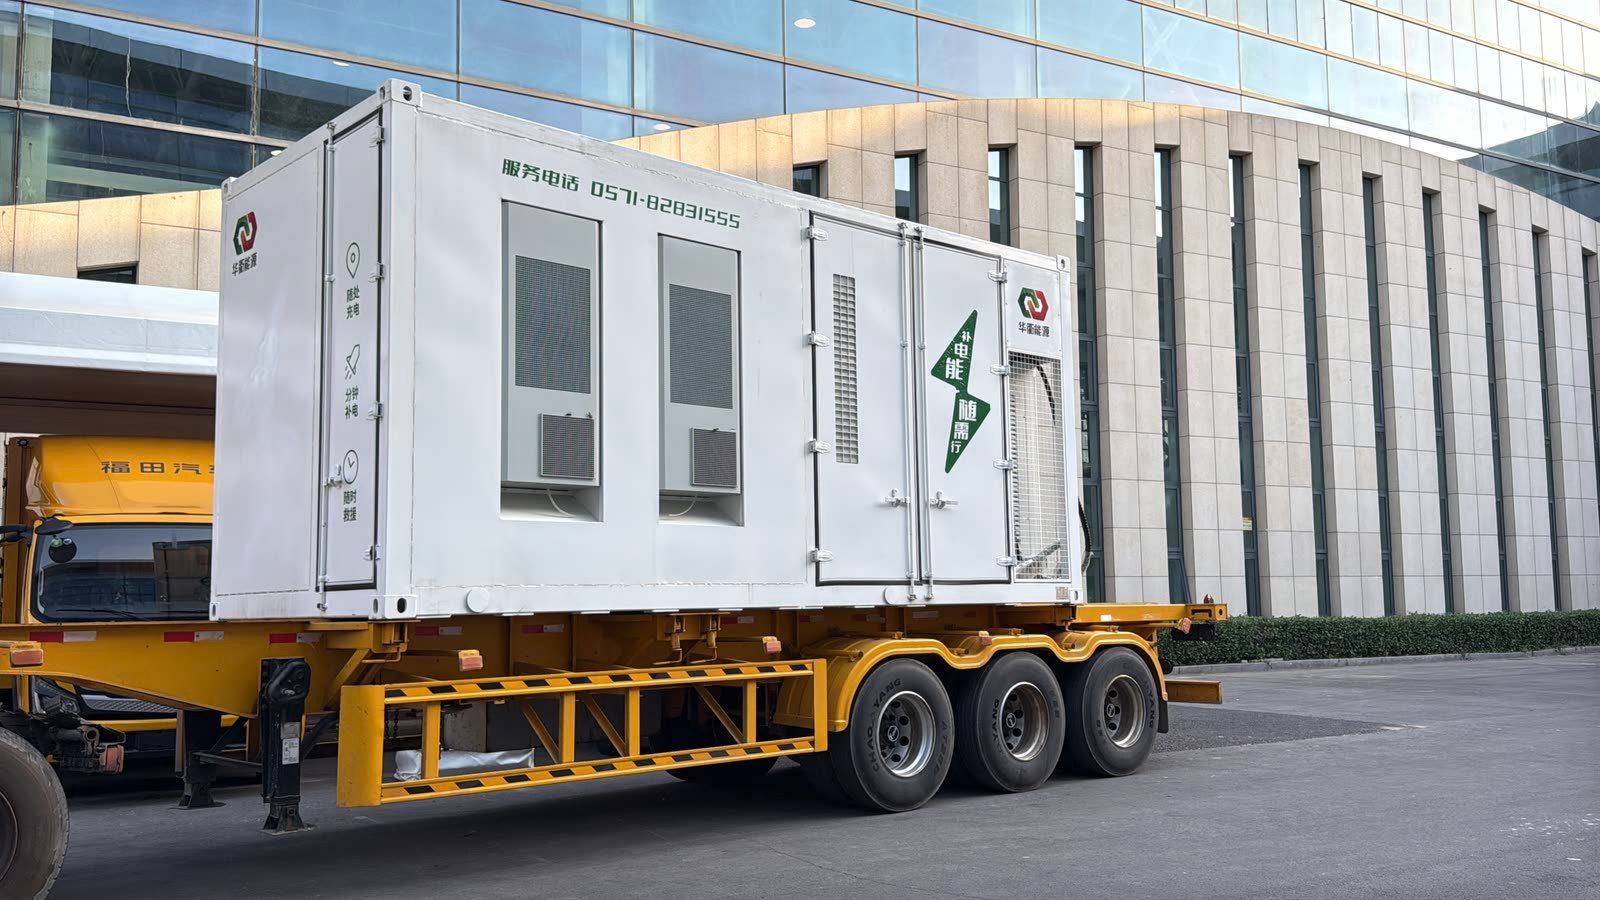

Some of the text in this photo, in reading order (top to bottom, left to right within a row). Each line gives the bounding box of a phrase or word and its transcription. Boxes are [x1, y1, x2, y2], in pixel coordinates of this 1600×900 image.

[502, 158, 741, 229] 服务电话 0571-82831555
[346, 284, 360, 303] 随处
[346, 302, 360, 320] 充电
[945, 331, 972, 380] 补电能
[345, 385, 359, 403] 分钟
[345, 403, 359, 420] 补电
[951, 399, 977, 453] 随需行
[343, 488, 357, 505] 随时
[343, 506, 357, 522] 救援
[873, 677, 901, 709] YANG
